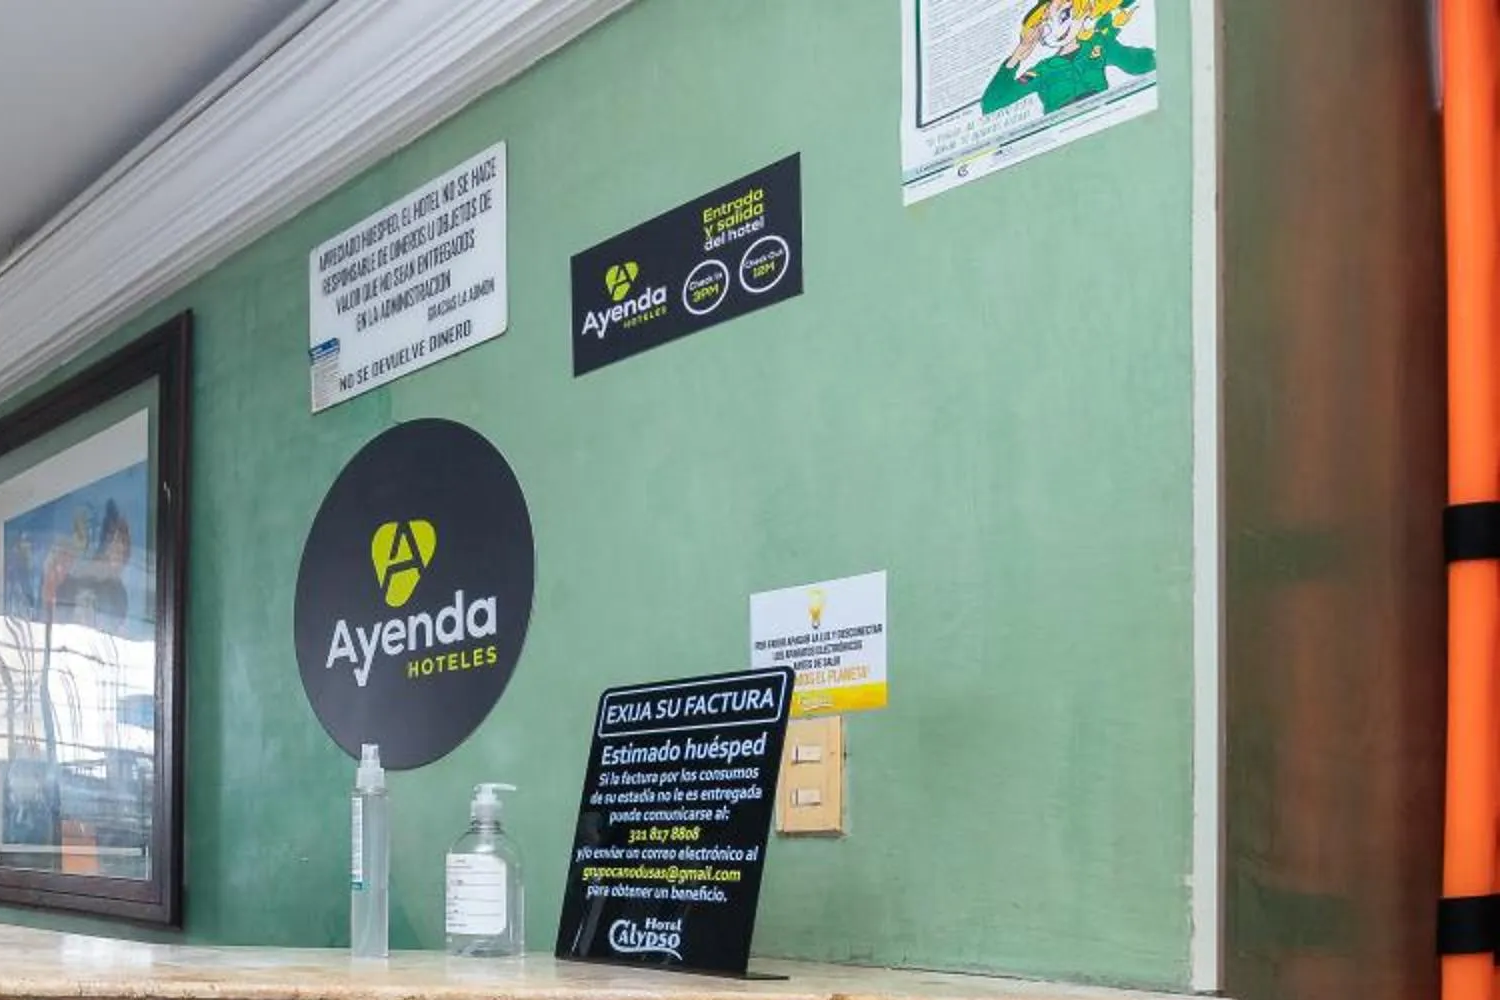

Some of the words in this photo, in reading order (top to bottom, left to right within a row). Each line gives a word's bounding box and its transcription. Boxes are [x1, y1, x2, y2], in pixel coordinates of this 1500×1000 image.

[401, 206, 412, 227] EL
[413, 189, 440, 221] HOTEL
[443, 180, 456, 204] NO
[457, 172, 469, 197] SE
[471, 156, 497, 189] HACE
[479, 189, 493, 213] DE
[703, 187, 765, 224] Entrada
[716, 201, 765, 232] salida
[704, 236, 727, 252] del
[727, 216, 766, 240] hotel
[691, 281, 721, 305] 3PM
[581, 286, 668, 338] Ayenda
[622, 305, 669, 329] HOTELES
[339, 372, 355, 392] NO
[357, 364, 370, 385] SE
[371, 338, 426, 378] DEVUELVE
[429, 318, 473, 354] DINERO
[325, 589, 498, 688] Ayenda
[407, 646, 498, 680] HOTELES
[606, 703, 651, 724] EXIJA
[654, 697, 682, 719] SU
[683, 686, 775, 717] FACTURA
[601, 739, 682, 766] Estimado
[683, 731, 767, 763] huésped
[598, 772, 609, 787] Si
[609, 771, 620, 785] la
[620, 769, 659, 785] factura
[658, 770, 680, 787] por
[680, 767, 698, 782] los
[698, 767, 760, 782] consumos
[589, 789, 603, 805] de
[617, 787, 655, 804] estadía
[657, 791, 673, 802] no
[685, 789, 699, 801] es
[700, 783, 763, 804] entregada
[608, 807, 643, 826] puede
[643, 805, 713, 821] comunicarse
[627, 829, 648, 843] 321
[649, 825, 670, 844] 817
[641, 848, 677, 860] correo
[677, 845, 744, 861] electrónico
[745, 844, 759, 861] al
[585, 884, 610, 900] para
[610, 882, 653, 898] obtener
[653, 886, 670, 899] un
[670, 884, 728, 903] beneficio.
